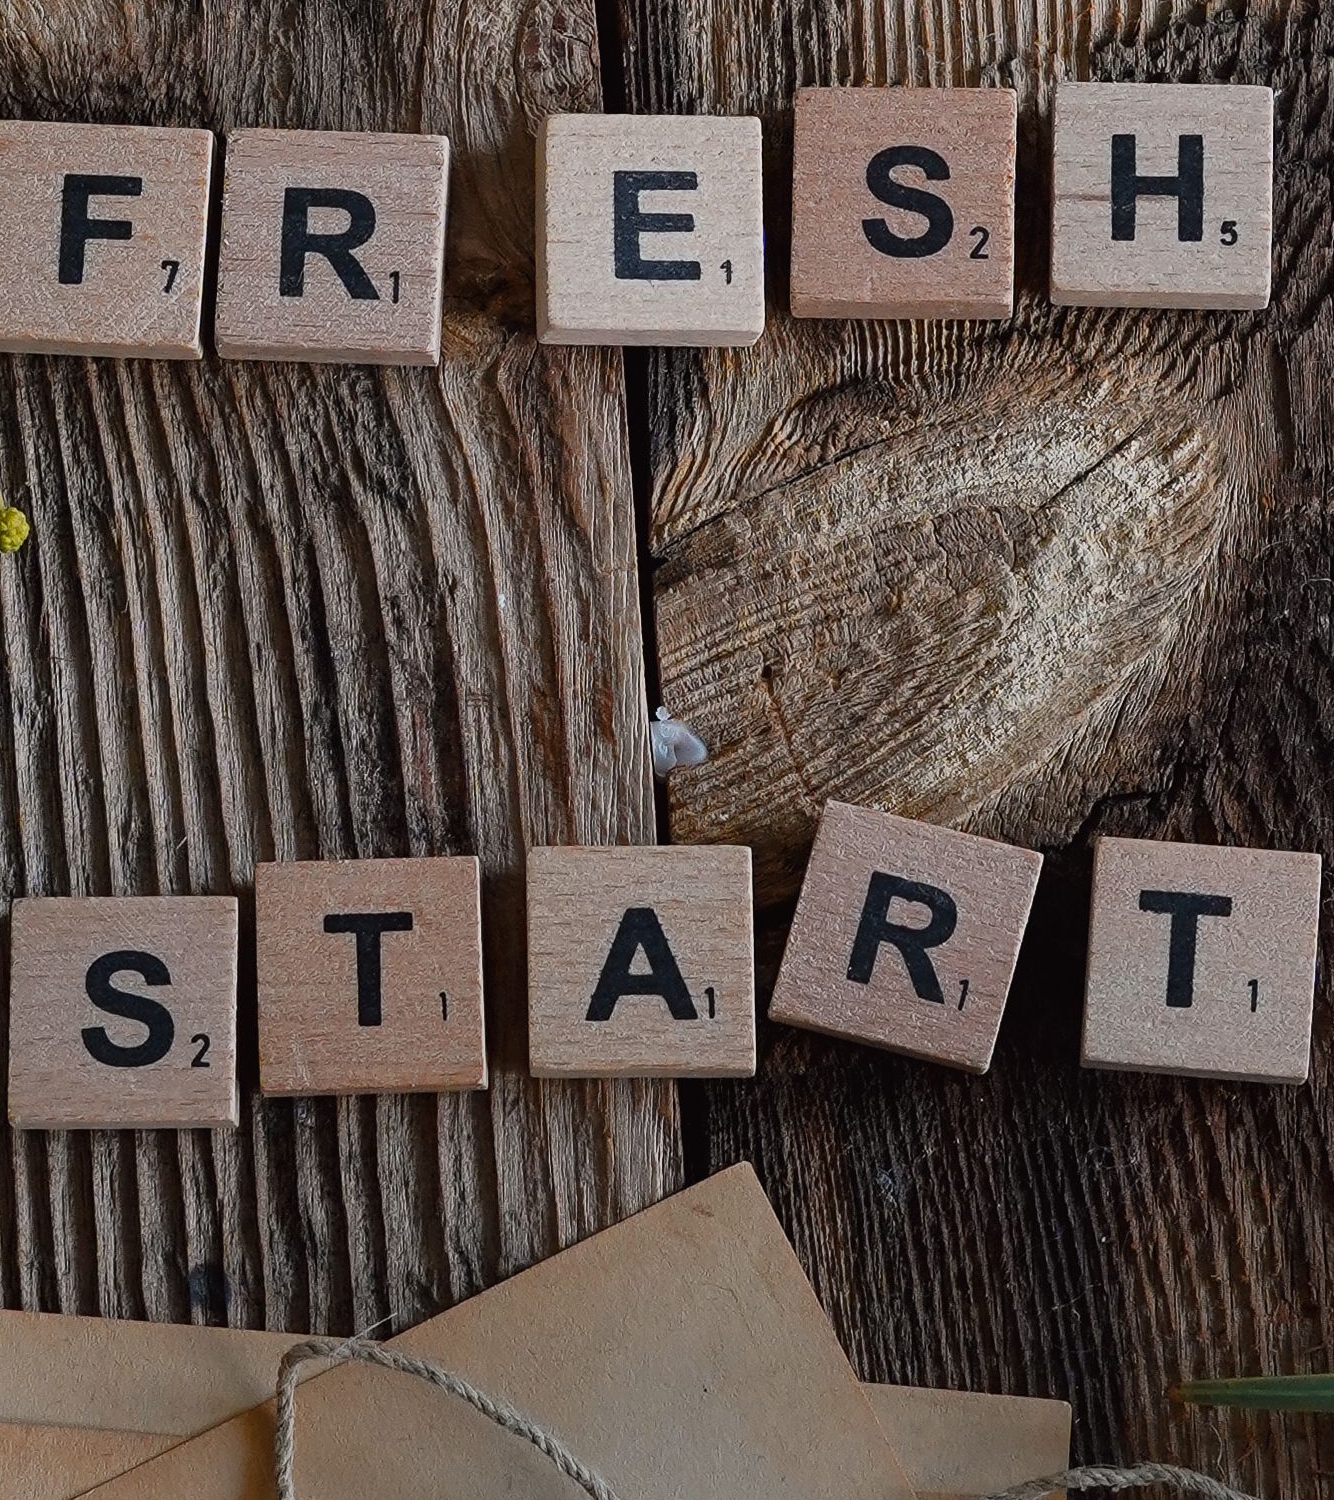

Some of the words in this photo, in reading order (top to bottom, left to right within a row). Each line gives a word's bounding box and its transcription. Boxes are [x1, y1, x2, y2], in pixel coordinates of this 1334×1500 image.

[58, 134, 1204, 300] FRESH
[970, 227, 989, 259] 2
[1221, 221, 1238, 246] 5
[161, 260, 179, 293] 7
[390, 271, 399, 304] 1
[720, 260, 732, 284] 1
[81, 871, 1233, 1068] START
[440, 992, 447, 1021] 1
[705, 987, 715, 1018] 1
[958, 980, 969, 1011] 1
[1248, 979, 1258, 1012] 1
[191, 1034, 210, 1067] 2
